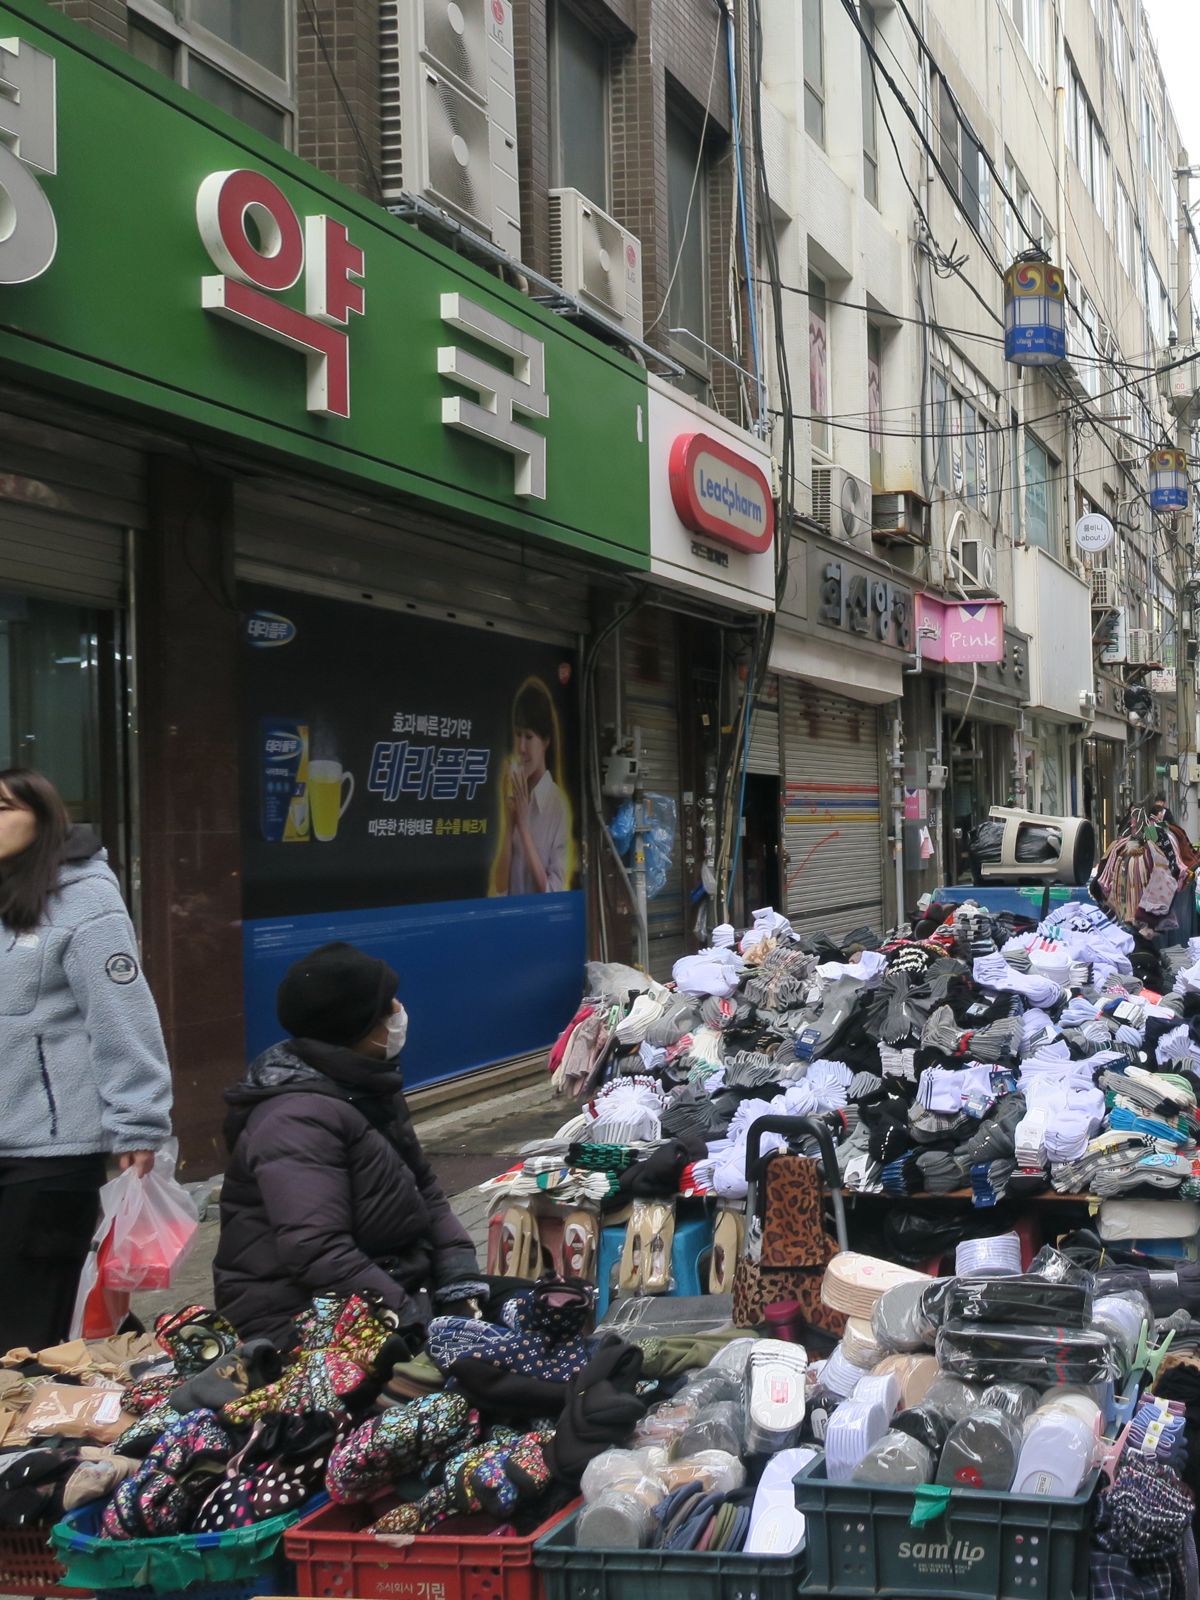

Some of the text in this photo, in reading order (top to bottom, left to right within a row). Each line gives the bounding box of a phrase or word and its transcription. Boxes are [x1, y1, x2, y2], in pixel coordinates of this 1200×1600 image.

[492, 23, 505, 44] LG
[627, 268, 637, 284] LG
[196, 168, 550, 500] 약국
[698, 467, 763, 524] Leadpharm
[247, 619, 289, 639] 테라플루
[949, 631, 998, 648] Pink
[392, 712, 472, 740] 효과 빠른 감기약
[367, 739, 491, 802] 테라플루
[367, 818, 397, 837] 따뜻한
[462, 817, 488, 835] 빠르게
[376, 1582, 446, 1600] 주식회사 기린
